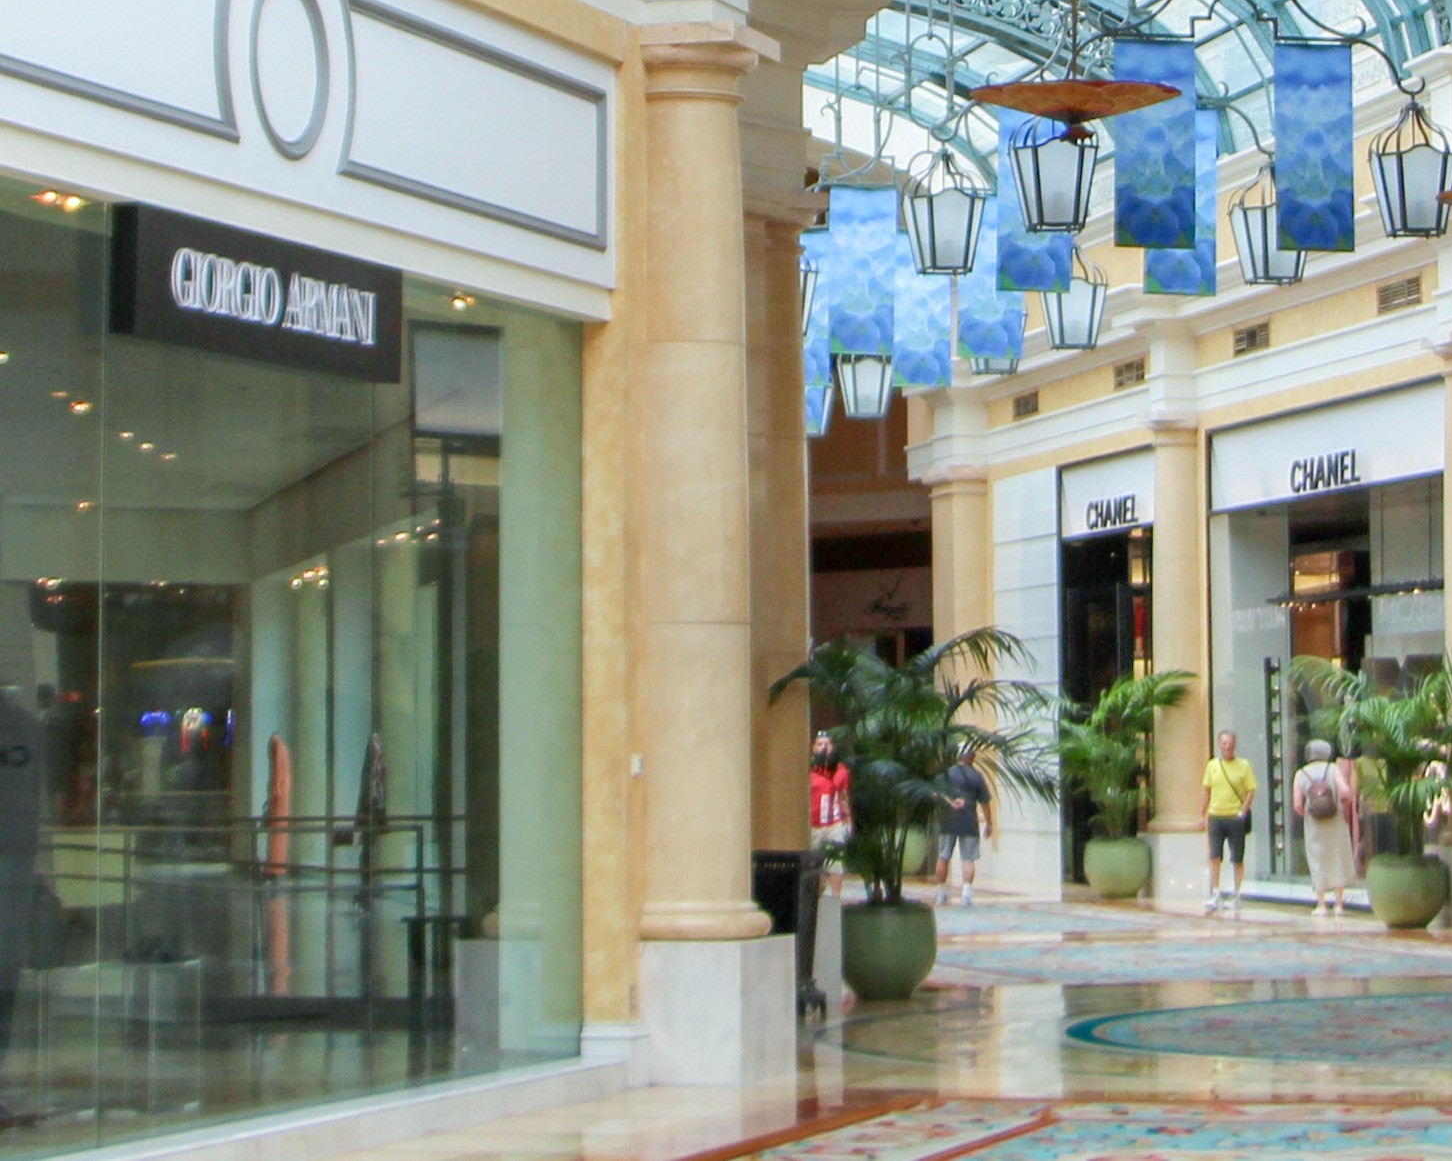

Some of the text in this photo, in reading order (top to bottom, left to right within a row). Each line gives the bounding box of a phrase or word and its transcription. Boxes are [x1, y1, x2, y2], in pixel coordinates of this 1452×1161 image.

[170, 246, 379, 346] GIORGIO ARMANI
[1290, 449, 1361, 494] CHANEL
[1085, 494, 1139, 530] CHANEL
